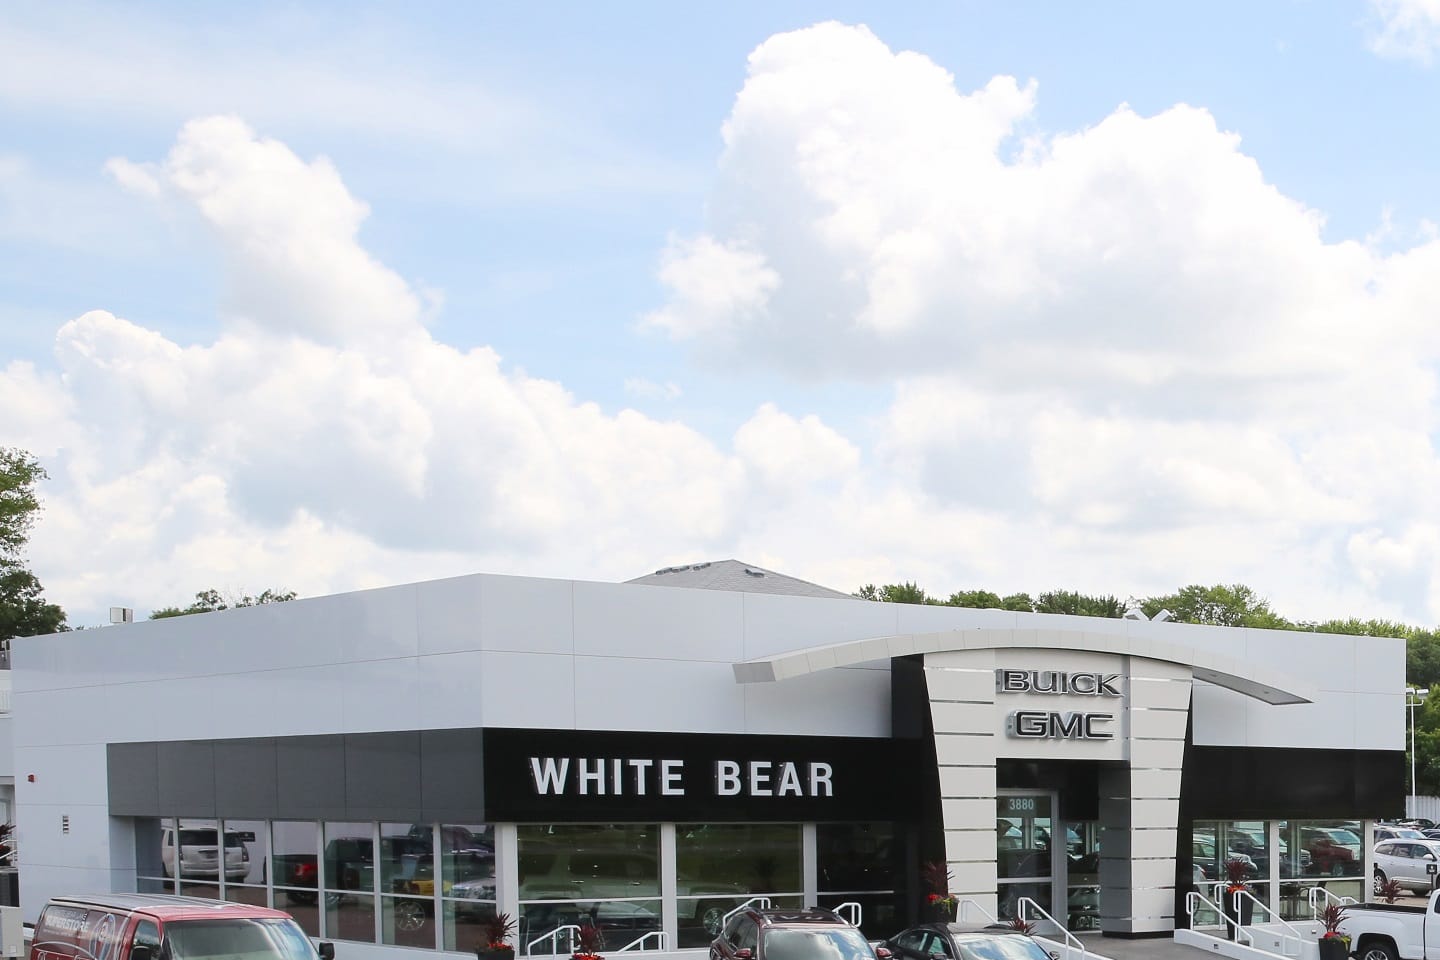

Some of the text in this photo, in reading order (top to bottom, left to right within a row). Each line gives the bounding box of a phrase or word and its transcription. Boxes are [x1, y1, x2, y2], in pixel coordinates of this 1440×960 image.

[997, 669, 1125, 698] BUICK
[1008, 709, 1115, 740] GMC
[529, 757, 834, 797] WHITE BEAR
[1009, 798, 1034, 810] 3880
